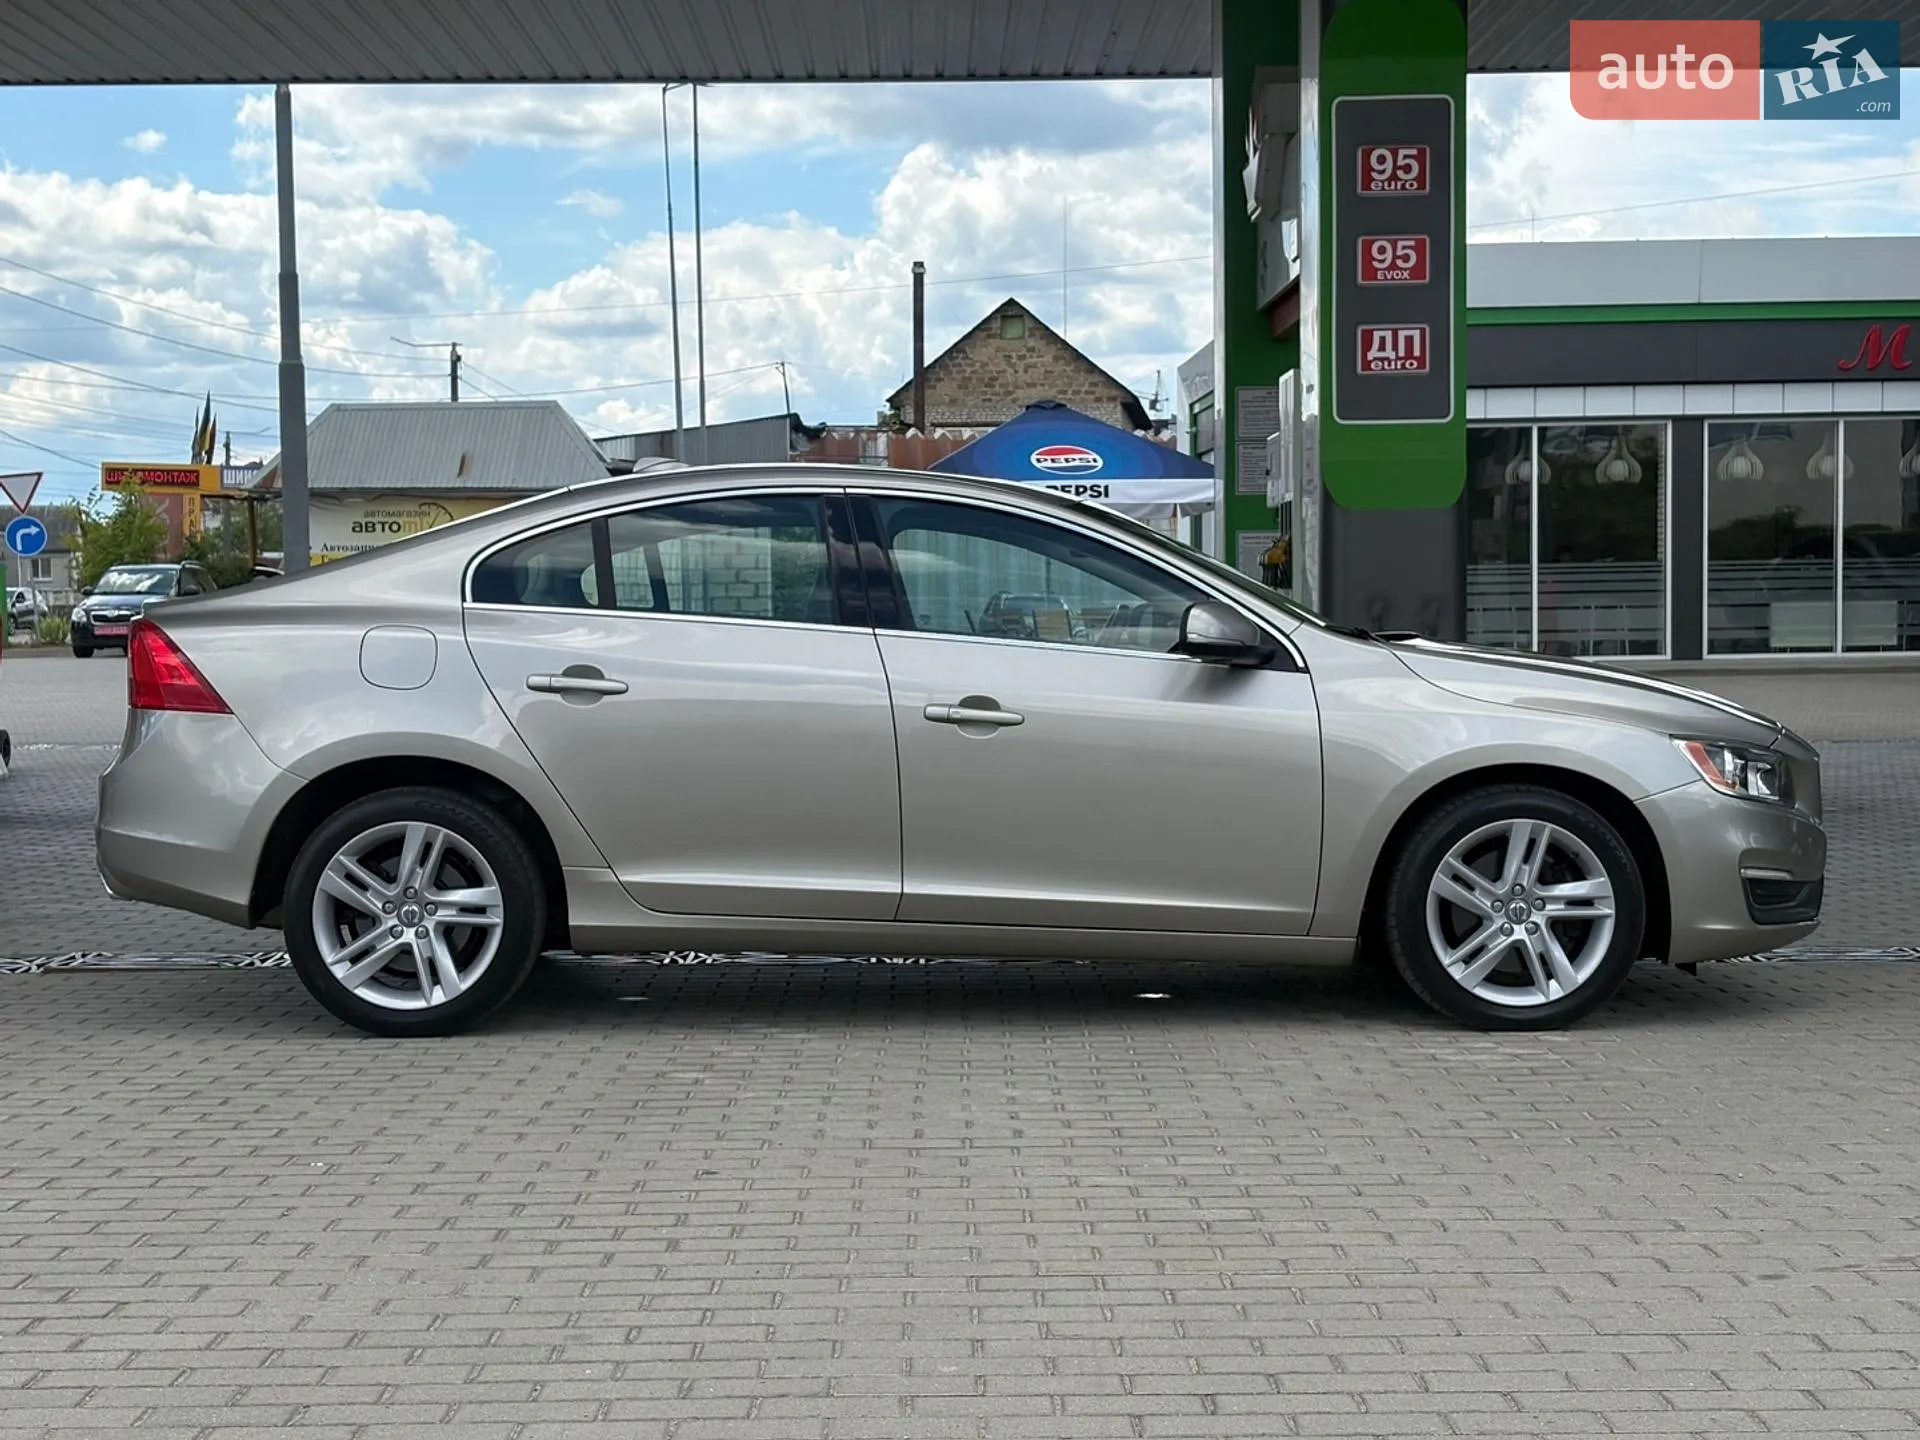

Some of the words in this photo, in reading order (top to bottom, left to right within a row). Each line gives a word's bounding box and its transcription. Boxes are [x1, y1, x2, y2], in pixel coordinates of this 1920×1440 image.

[1370, 148, 1419, 180] 95
[1370, 180, 1418, 191] euro
[1371, 240, 1417, 269] 95
[1377, 270, 1411, 280] EVOX
[1367, 328, 1421, 361] ДП
[1370, 359, 1418, 370] euro
[106, 471, 198, 484] ШИОМОНТАЖ
[363, 510, 430, 518] автомагазин
